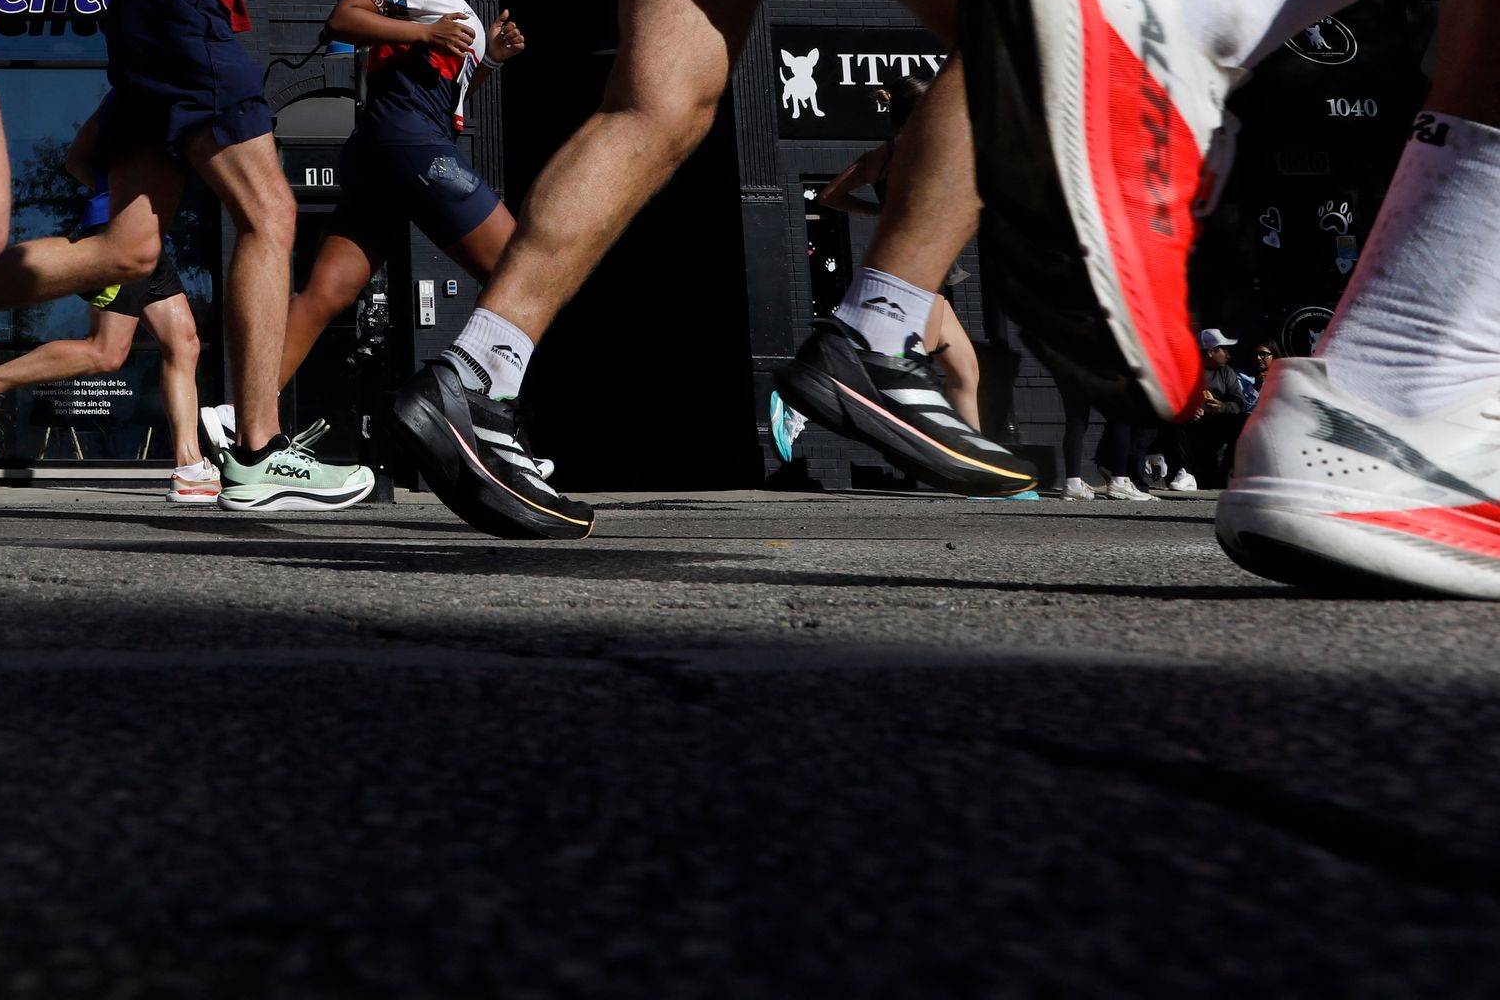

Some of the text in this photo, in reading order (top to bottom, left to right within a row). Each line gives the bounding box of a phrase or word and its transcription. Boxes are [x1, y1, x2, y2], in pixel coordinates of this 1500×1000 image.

[1326, 98, 1378, 117] 1040
[490, 346, 510, 363] MORE
[88, 389, 108, 397] tarjeta
[265, 462, 311, 480] HOKA
